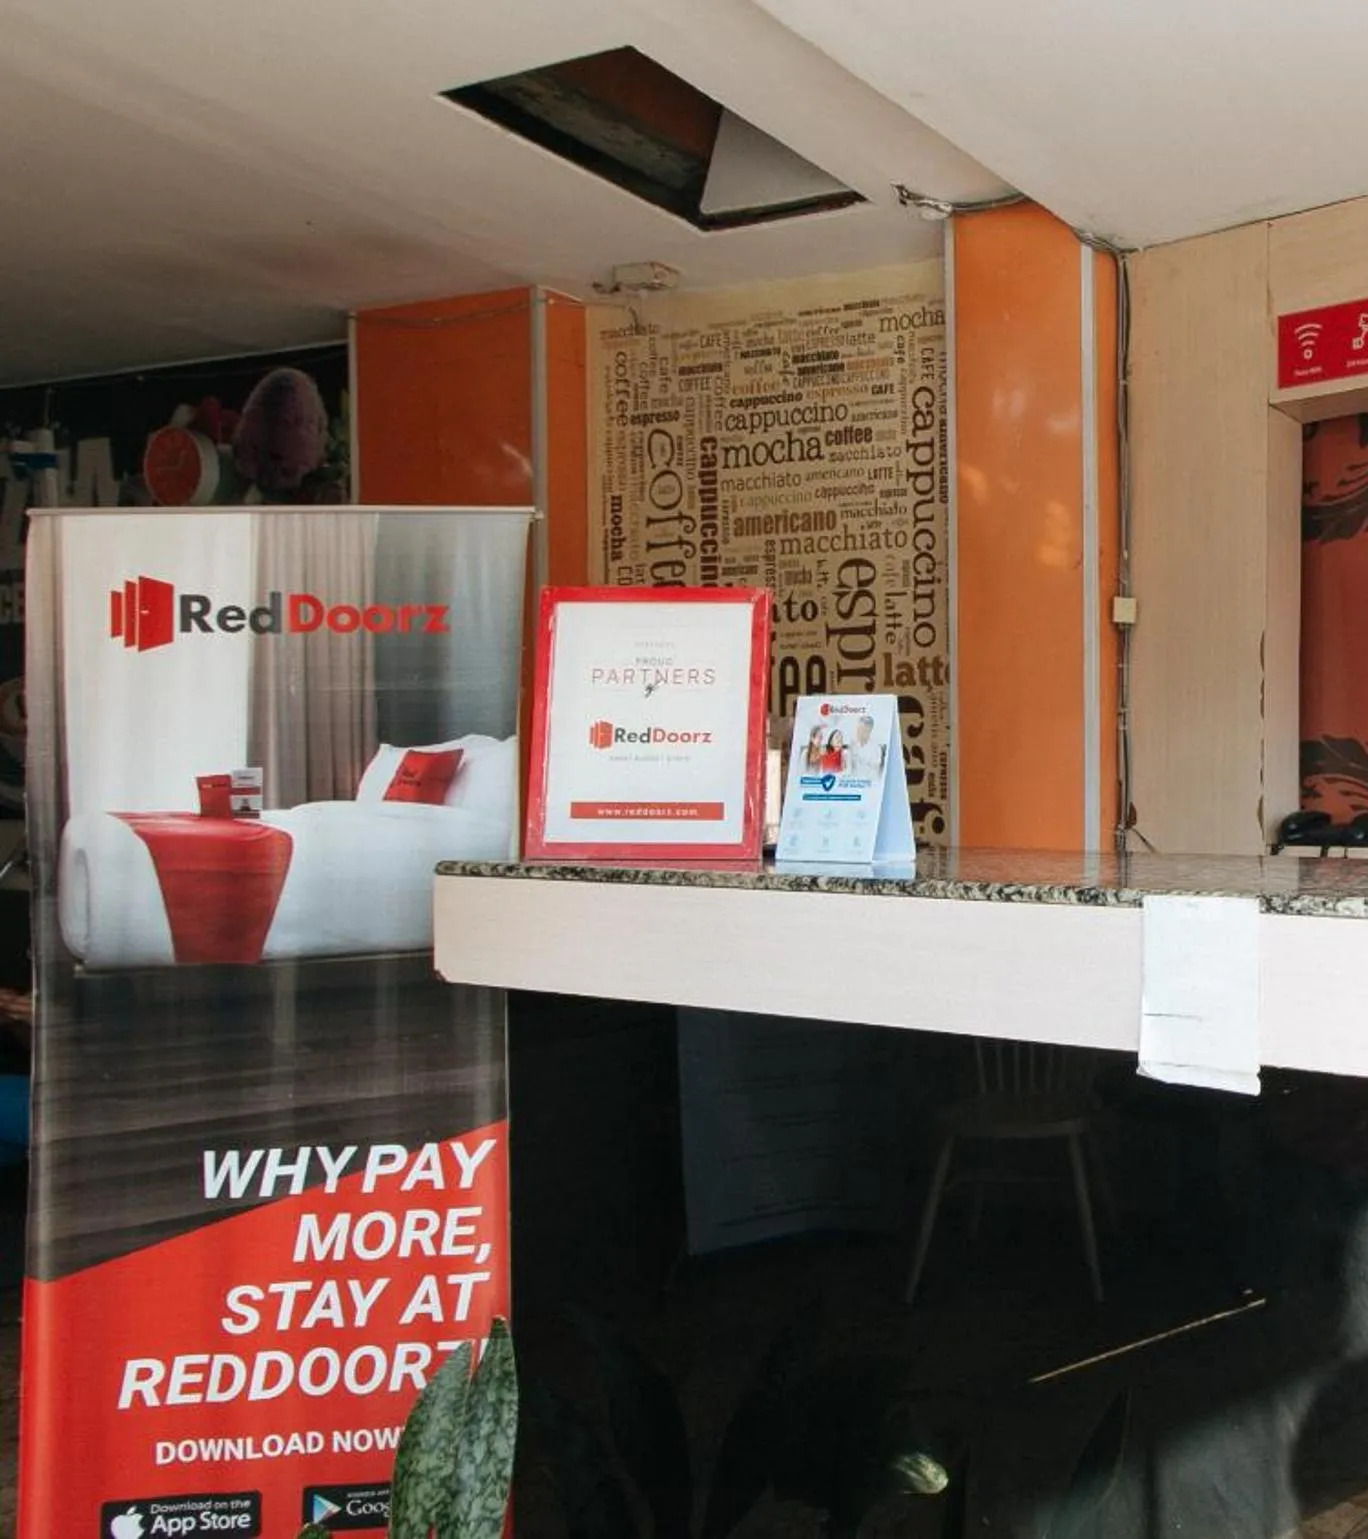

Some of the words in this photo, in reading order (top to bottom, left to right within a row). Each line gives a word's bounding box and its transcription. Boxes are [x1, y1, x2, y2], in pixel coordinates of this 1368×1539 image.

[878, 304, 946, 334] mocha
[921, 347, 935, 381] CAFE
[615, 351, 630, 428] coffee
[729, 390, 803, 411] cappuccino
[724, 401, 849, 434] cappuccino
[721, 430, 826, 470] mocha
[824, 426, 874, 447] coffee
[720, 470, 803, 495] macchiato
[610, 494, 626, 562] mocha
[733, 509, 838, 538] americano
[907, 385, 942, 649] cappuccino
[779, 523, 909, 556] macchiato
[179, 590, 451, 635] RedDoorz
[824, 557, 881, 694] espr
[591, 667, 716, 686] PARTNERS
[614, 727, 713, 745] RedDoorz
[203, 1145, 359, 1200] WHY
[361, 1138, 498, 1195] PAY
[292, 1206, 494, 1264] MORE,
[221, 1277, 390, 1335] STAY
[399, 1271, 492, 1326] AT
[155, 1431, 325, 1466] DOWNLOAD
[150, 1501, 212, 1515] Download
[213, 1501, 227, 1510] on
[229, 1499, 251, 1510] the
[150, 1514, 197, 1537] App
[199, 1510, 251, 1531] Store
